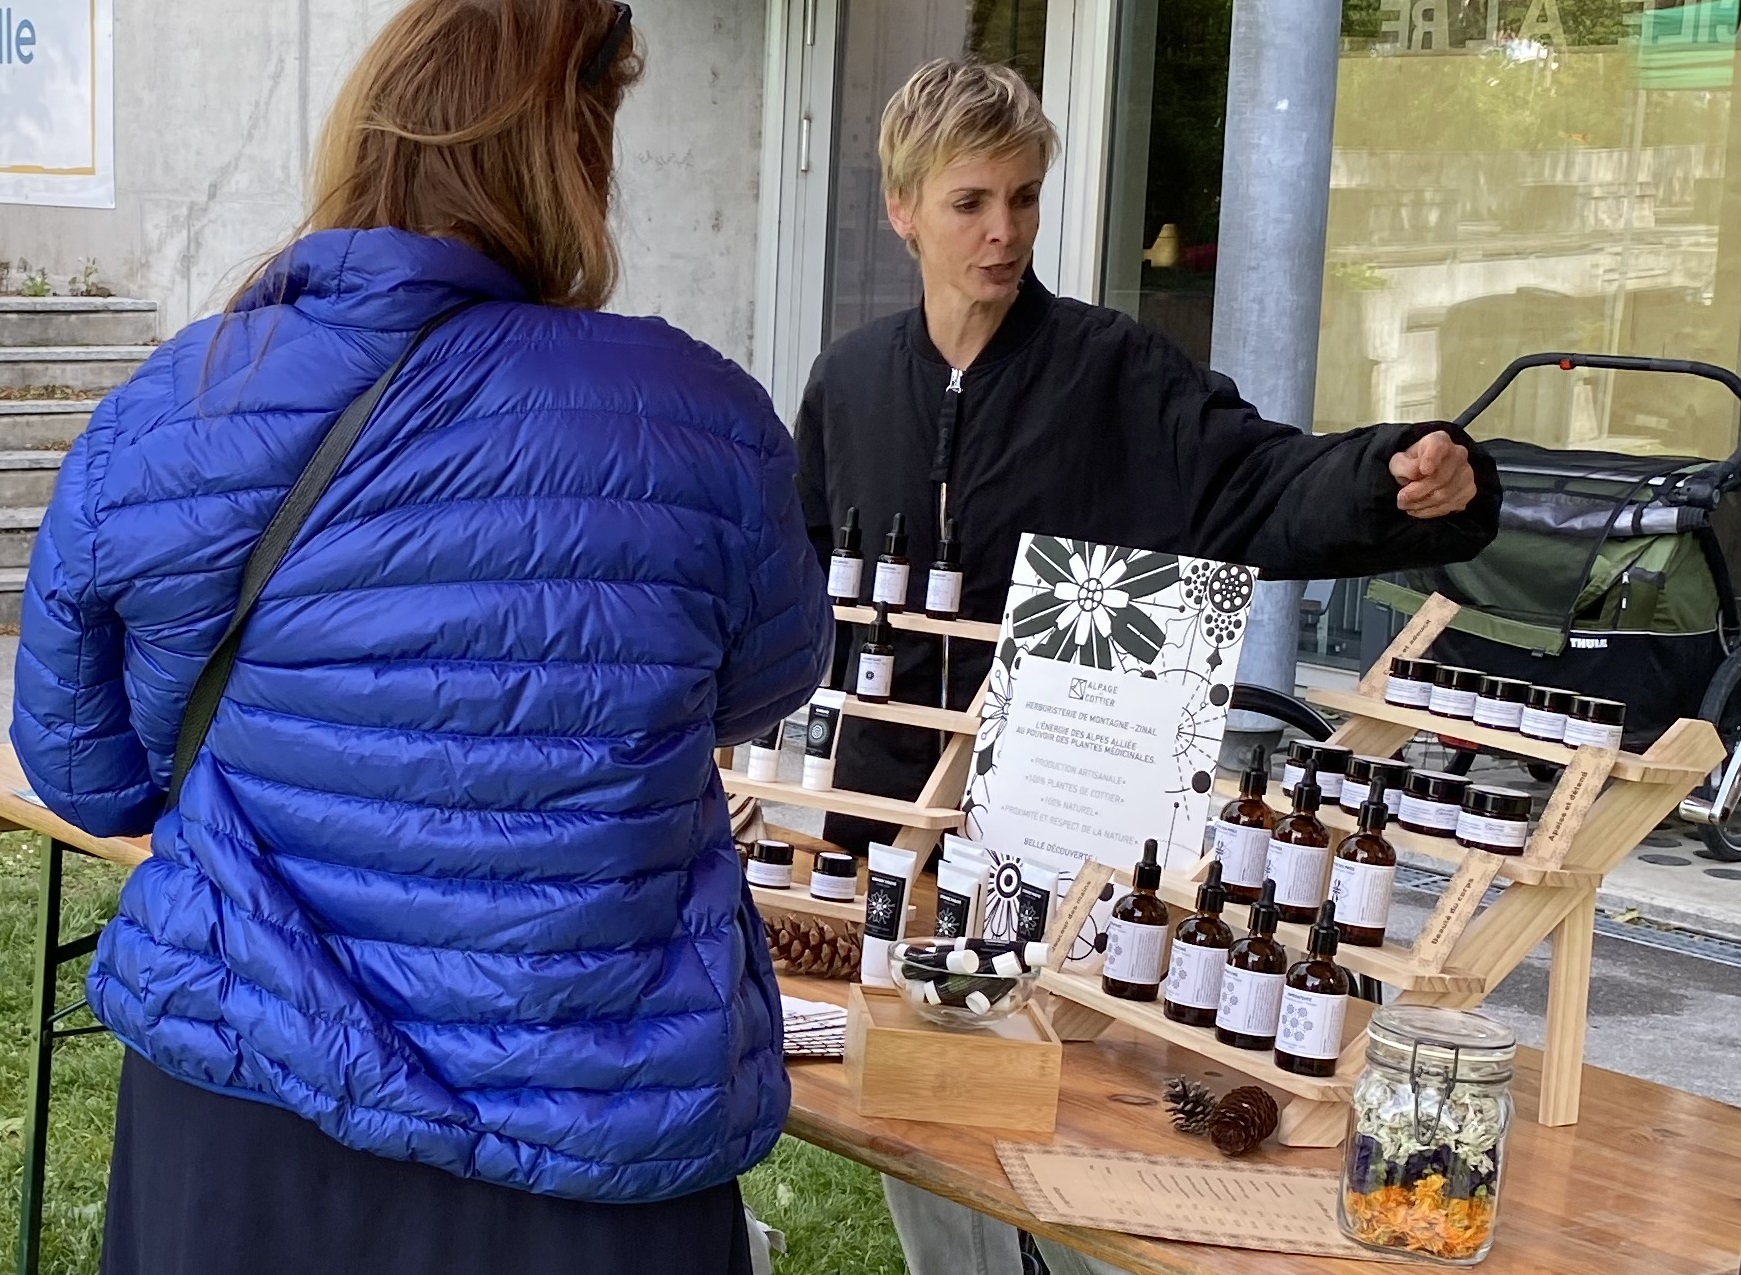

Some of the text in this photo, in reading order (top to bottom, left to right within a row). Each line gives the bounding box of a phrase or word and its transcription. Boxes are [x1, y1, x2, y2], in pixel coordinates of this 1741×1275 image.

[1569, 637, 1608, 649] THULE
[1087, 681, 1118, 694] ALPAGE
[1084, 694, 1116, 707] COTTIER
[1025, 701, 1077, 719] HERBORISTERIE
[1078, 712, 1088, 721] DE
[1089, 715, 1129, 730] MONTAGNE
[1135, 724, 1158, 737] ZINAL
[1016, 726, 1025, 735] AU
[1026, 728, 1055, 741] POUVOIR
[1055, 734, 1069, 745] DES
[1071, 738, 1103, 753] PLANTES
[1070, 728, 1084, 739] DES
[1085, 732, 1110, 744] ALPES
[1110, 737, 1138, 751] ALLIÉE
[1047, 778, 1078, 794] PLANTES
[1079, 786, 1089, 796] DE
[1548, 771, 1588, 842] Apaise et détend
[1039, 813, 1048, 822] ET
[1050, 816, 1080, 831] RESPECT
[1081, 824, 1091, 834] DE
[1092, 828, 1102, 837] LA
[1104, 830, 1134, 846] NATURE
[1024, 838, 1045, 850] BELLE
[1046, 843, 1093, 860] DÉCOUVERTE
[1458, 878, 1474, 902] corps
[1068, 905, 1078, 920] des
